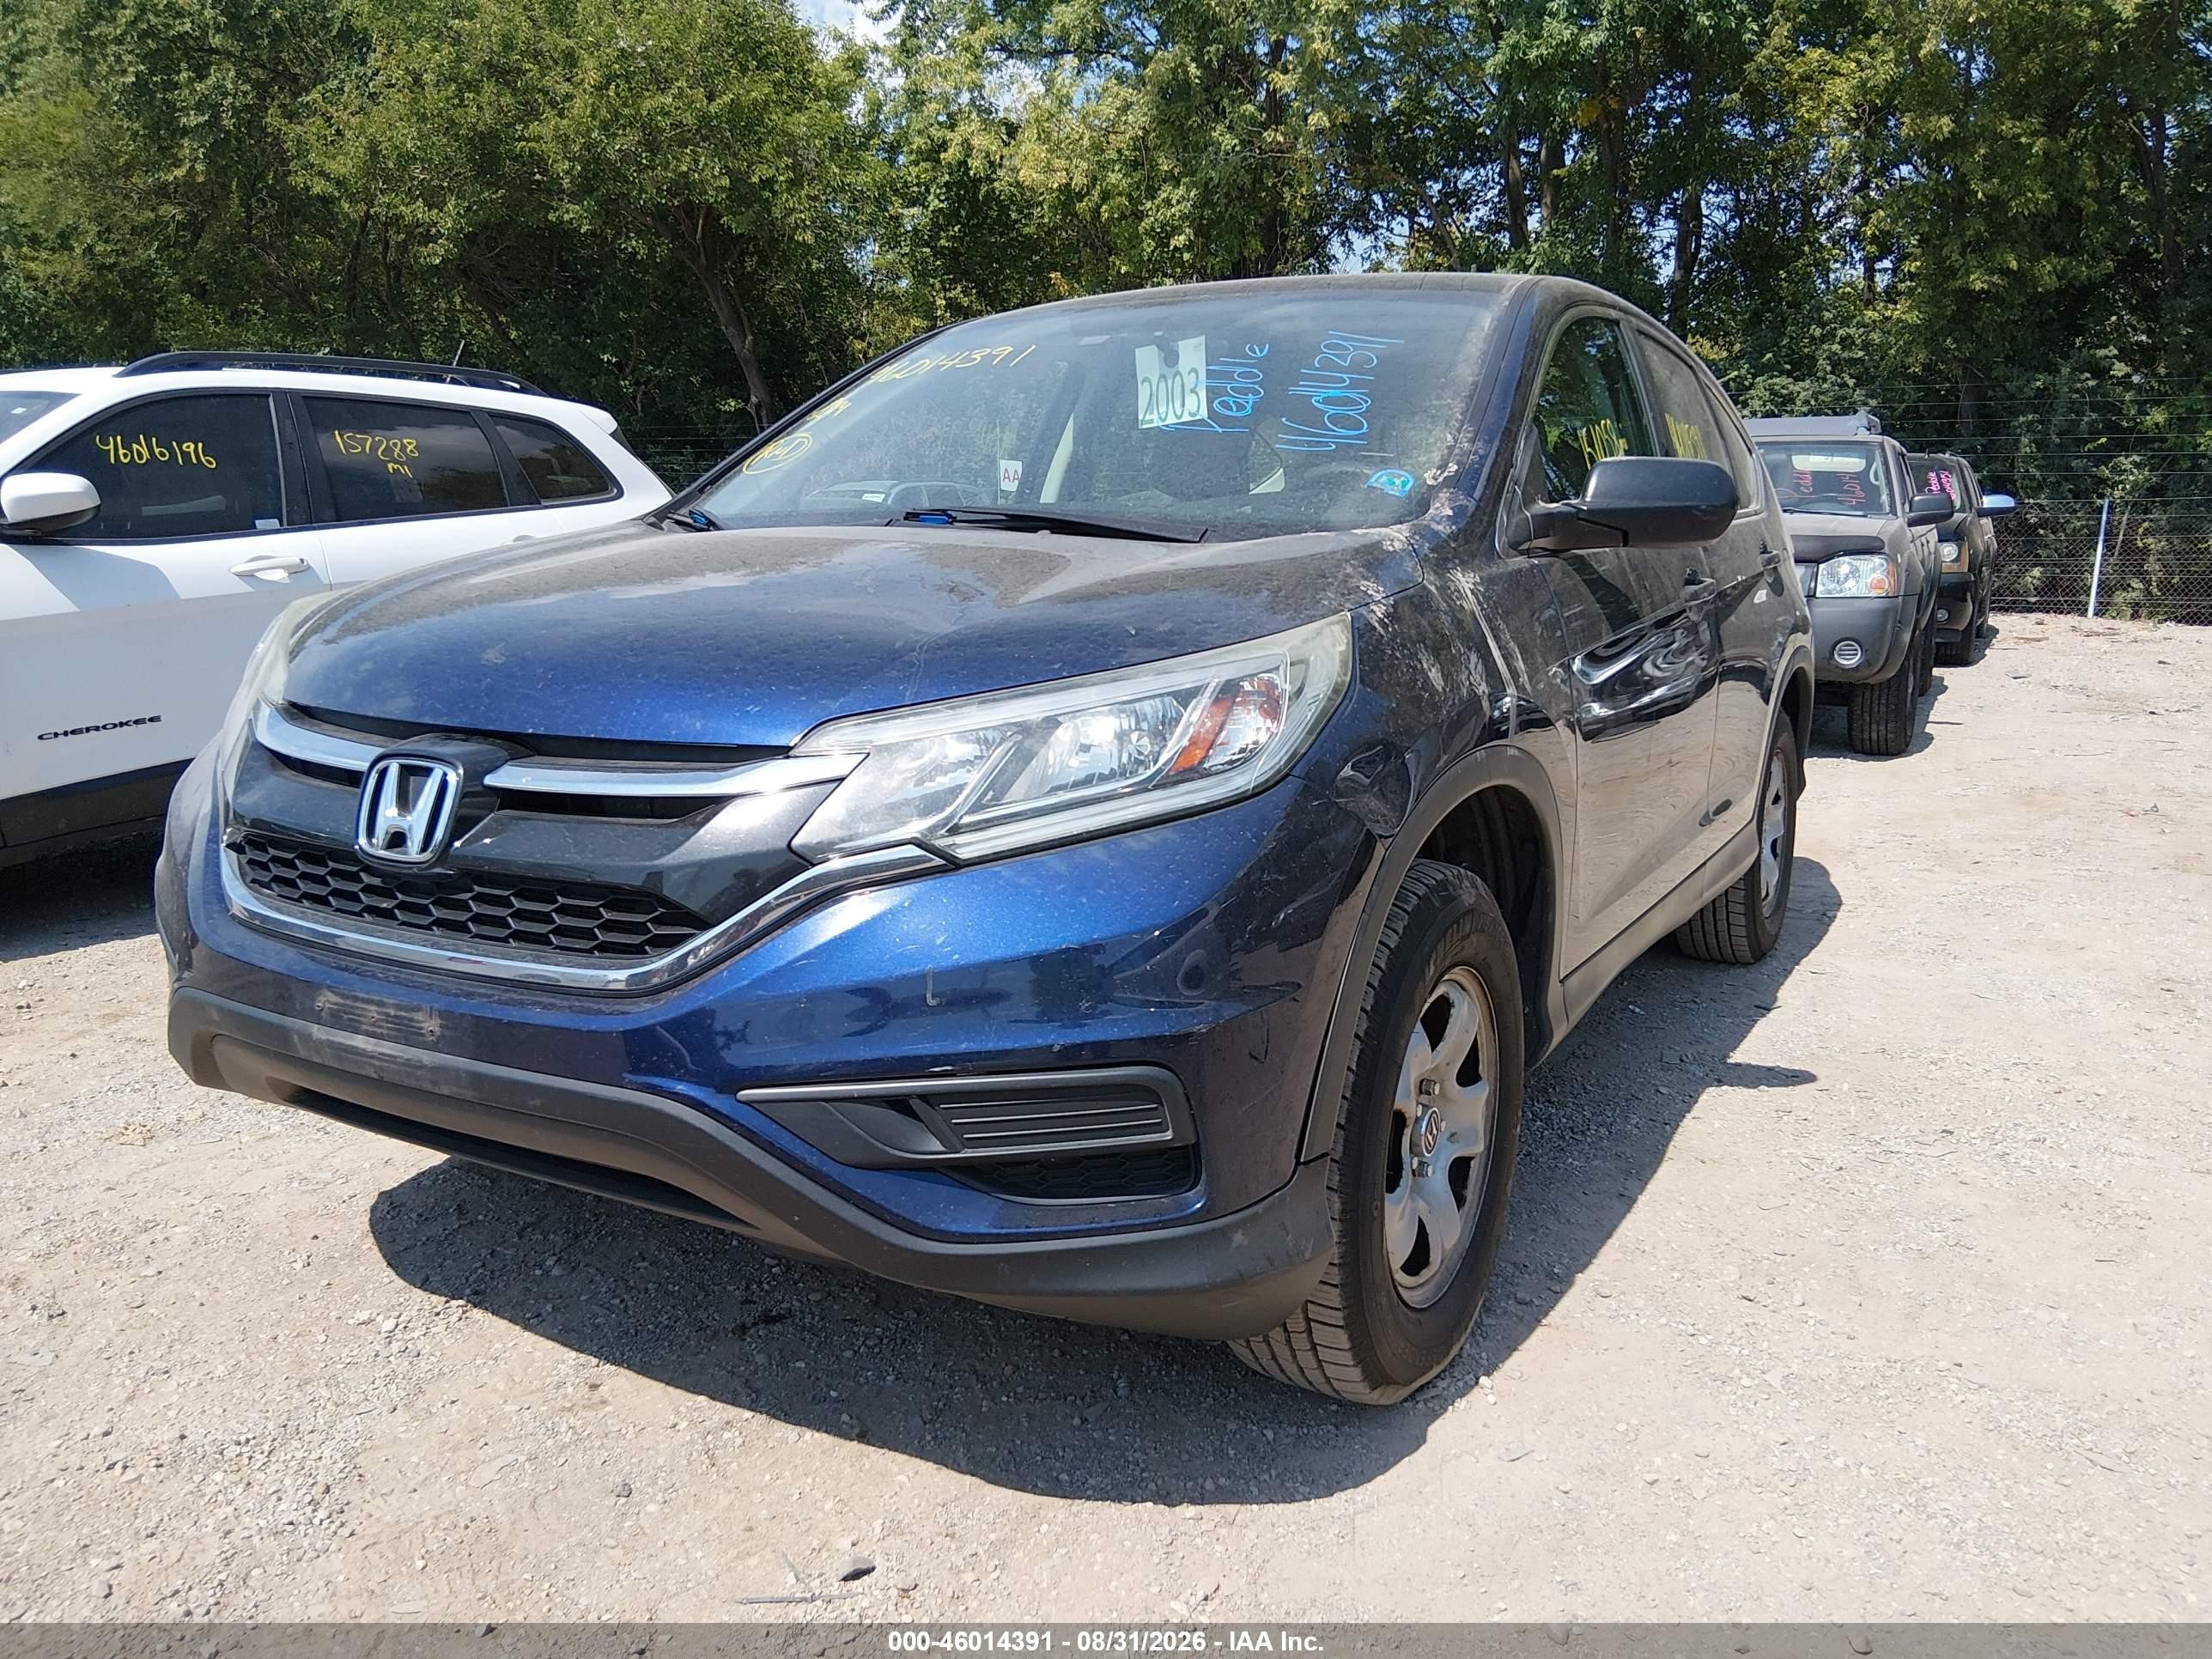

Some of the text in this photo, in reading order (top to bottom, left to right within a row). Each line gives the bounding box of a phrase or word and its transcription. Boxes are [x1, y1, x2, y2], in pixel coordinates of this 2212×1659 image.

[1139, 366, 1203, 428] 2003
[1274, 331, 1405, 451] 46014391
[95, 434, 217, 469] 46016196
[333, 428, 420, 461] 157288
[37, 714, 163, 741] CHEROKEE
